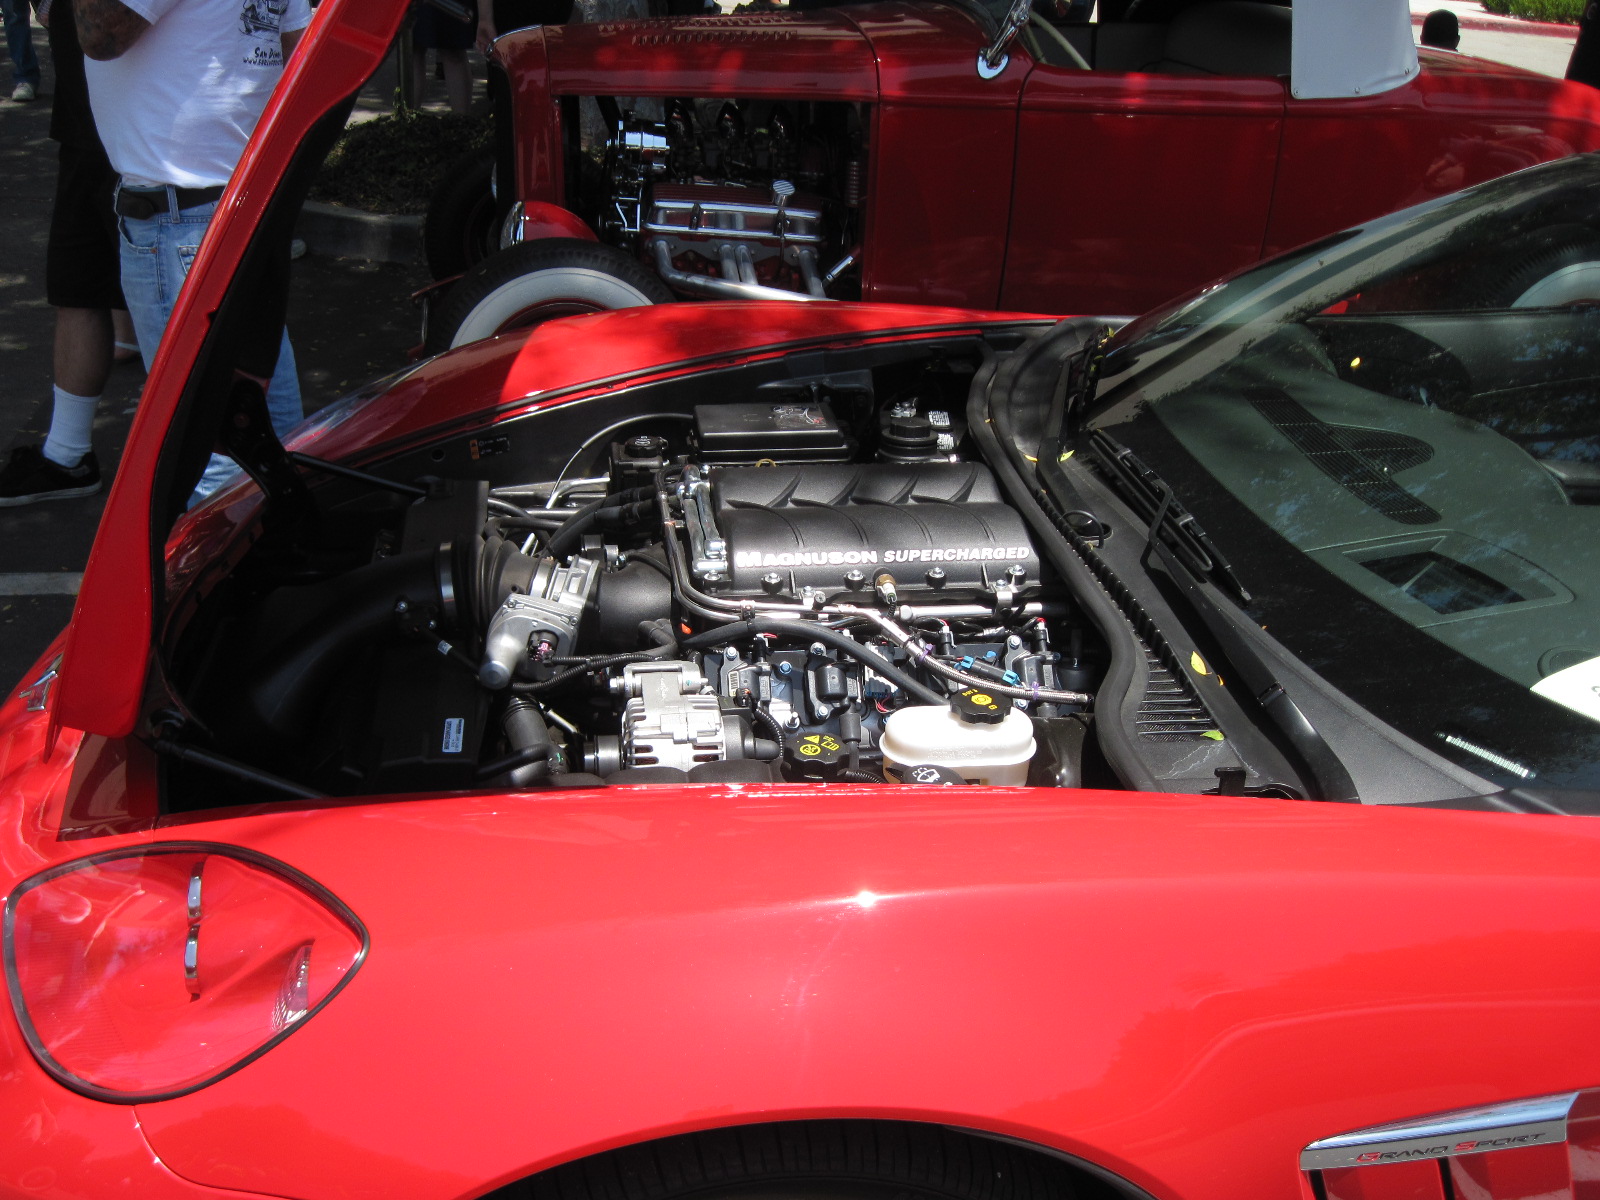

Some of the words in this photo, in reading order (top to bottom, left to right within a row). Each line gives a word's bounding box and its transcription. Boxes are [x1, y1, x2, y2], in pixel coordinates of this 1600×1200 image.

[736, 550, 878, 568] MAGNUSON
[883, 546, 1030, 564] SUPERCHARGED
[1356, 1145, 1448, 1162] GRAND
[1455, 1132, 1546, 1151] SPORT
